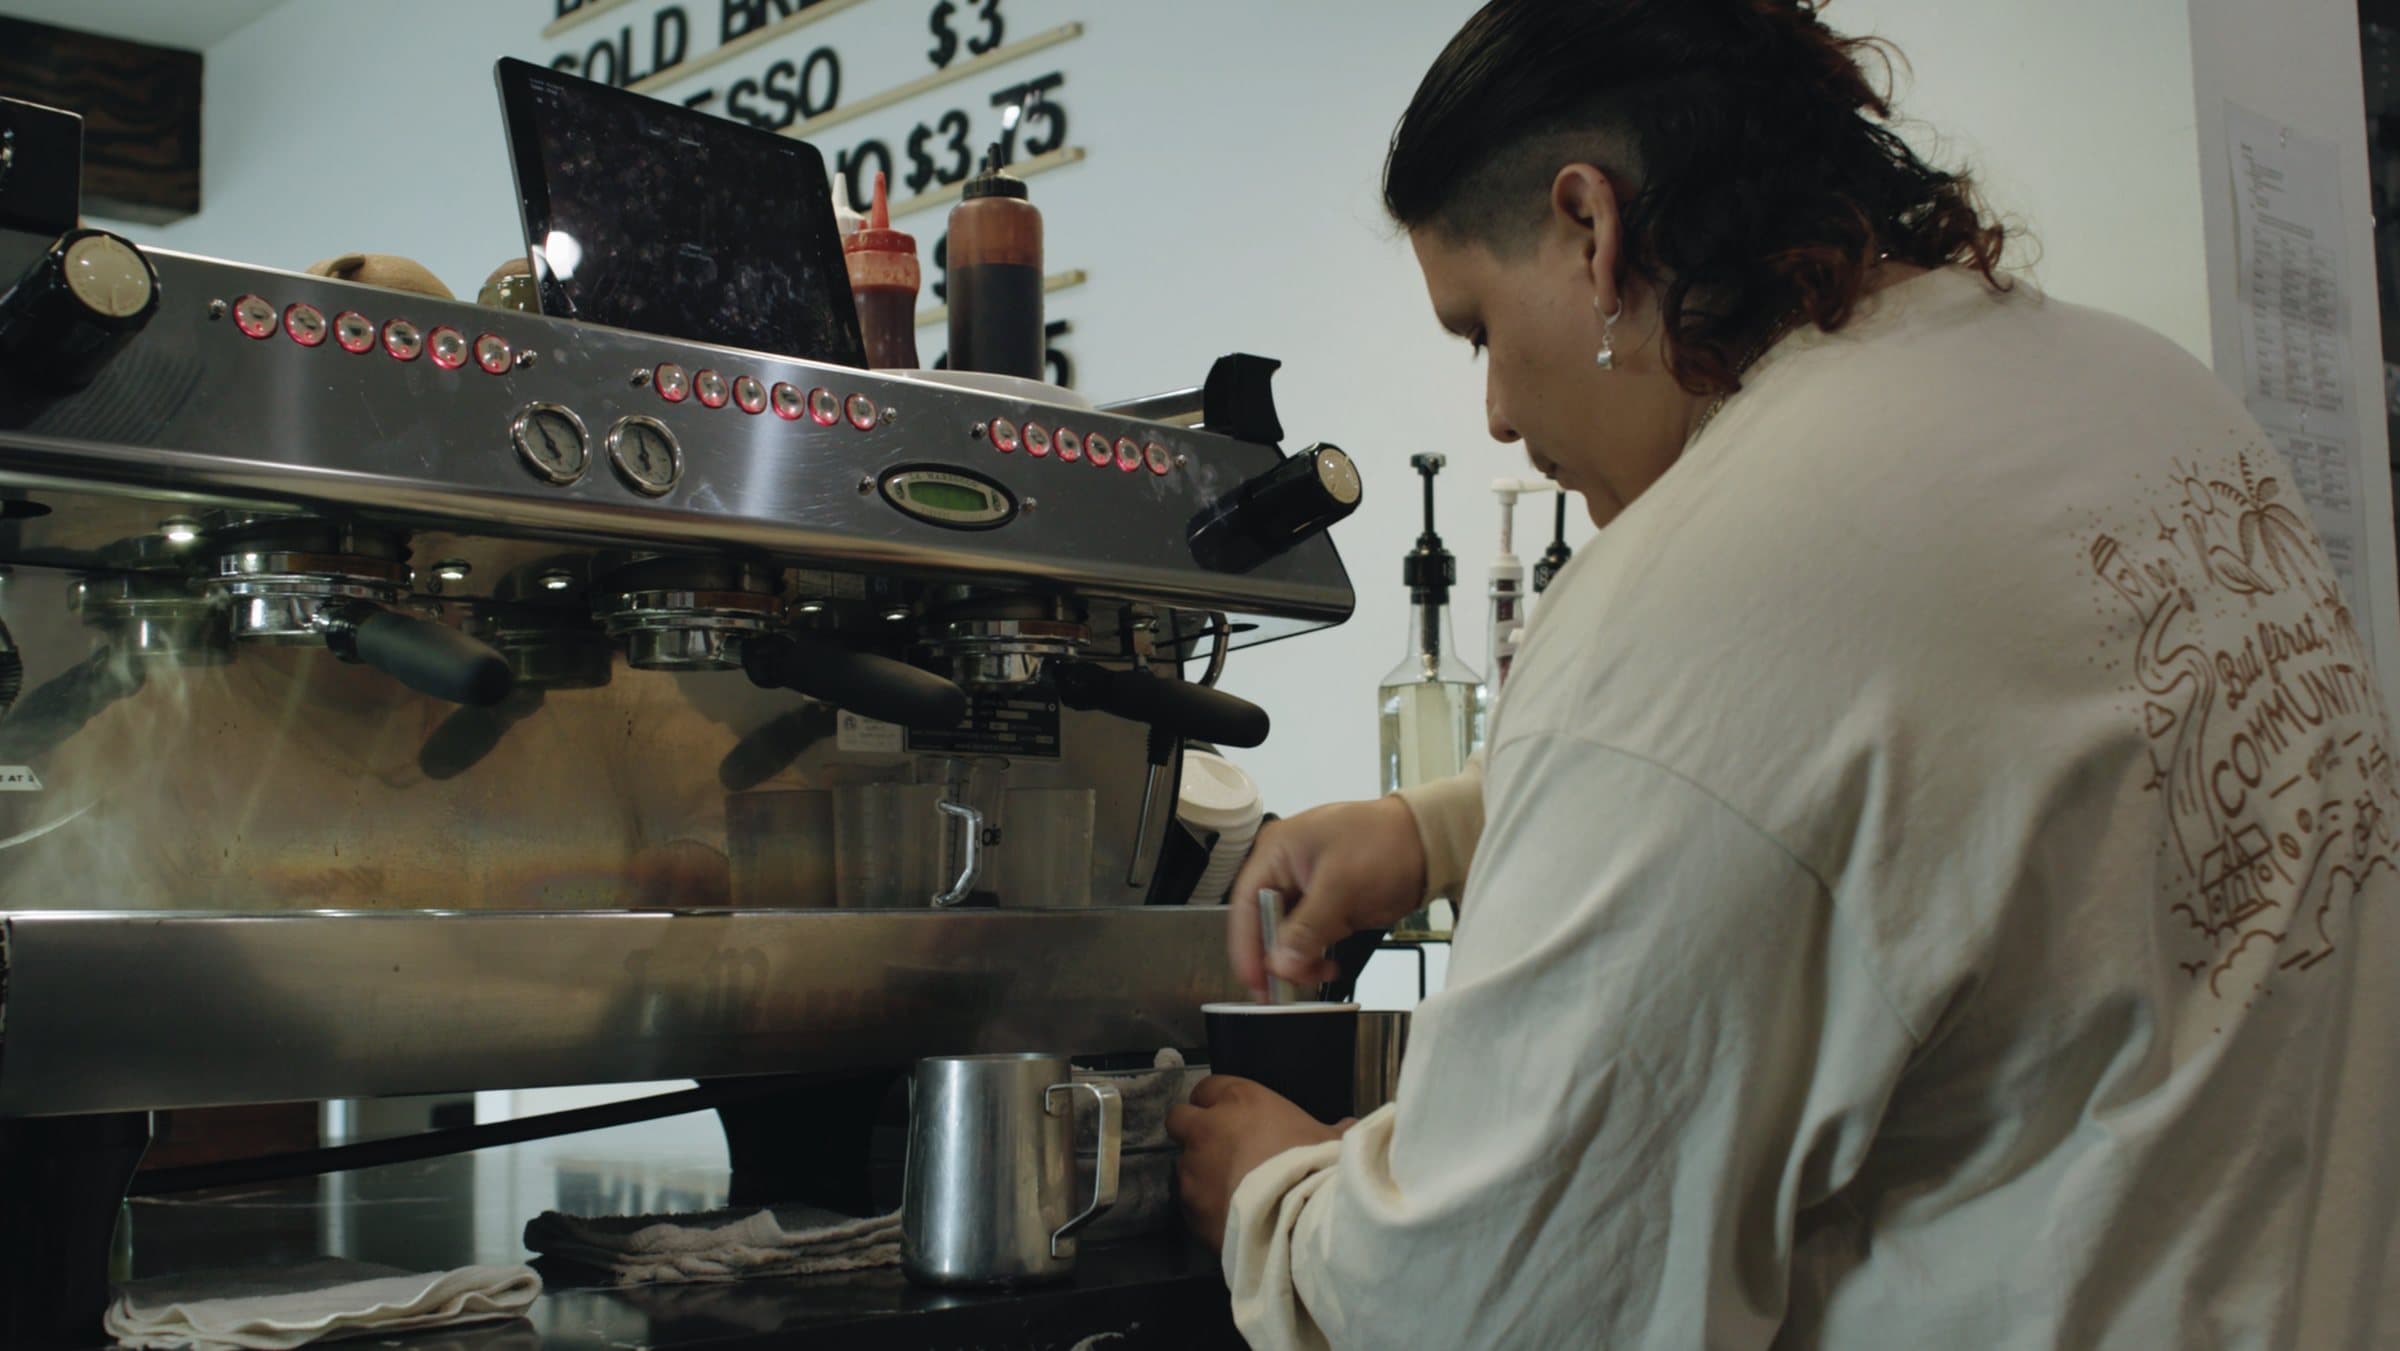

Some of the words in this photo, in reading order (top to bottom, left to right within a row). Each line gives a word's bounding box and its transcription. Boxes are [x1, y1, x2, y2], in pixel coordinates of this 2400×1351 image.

[684, 47, 839, 130] SSO
[928, 0, 1004, 69] $3
[2215, 636, 2263, 711] But
[2211, 664, 2373, 818] COMMUNITY
